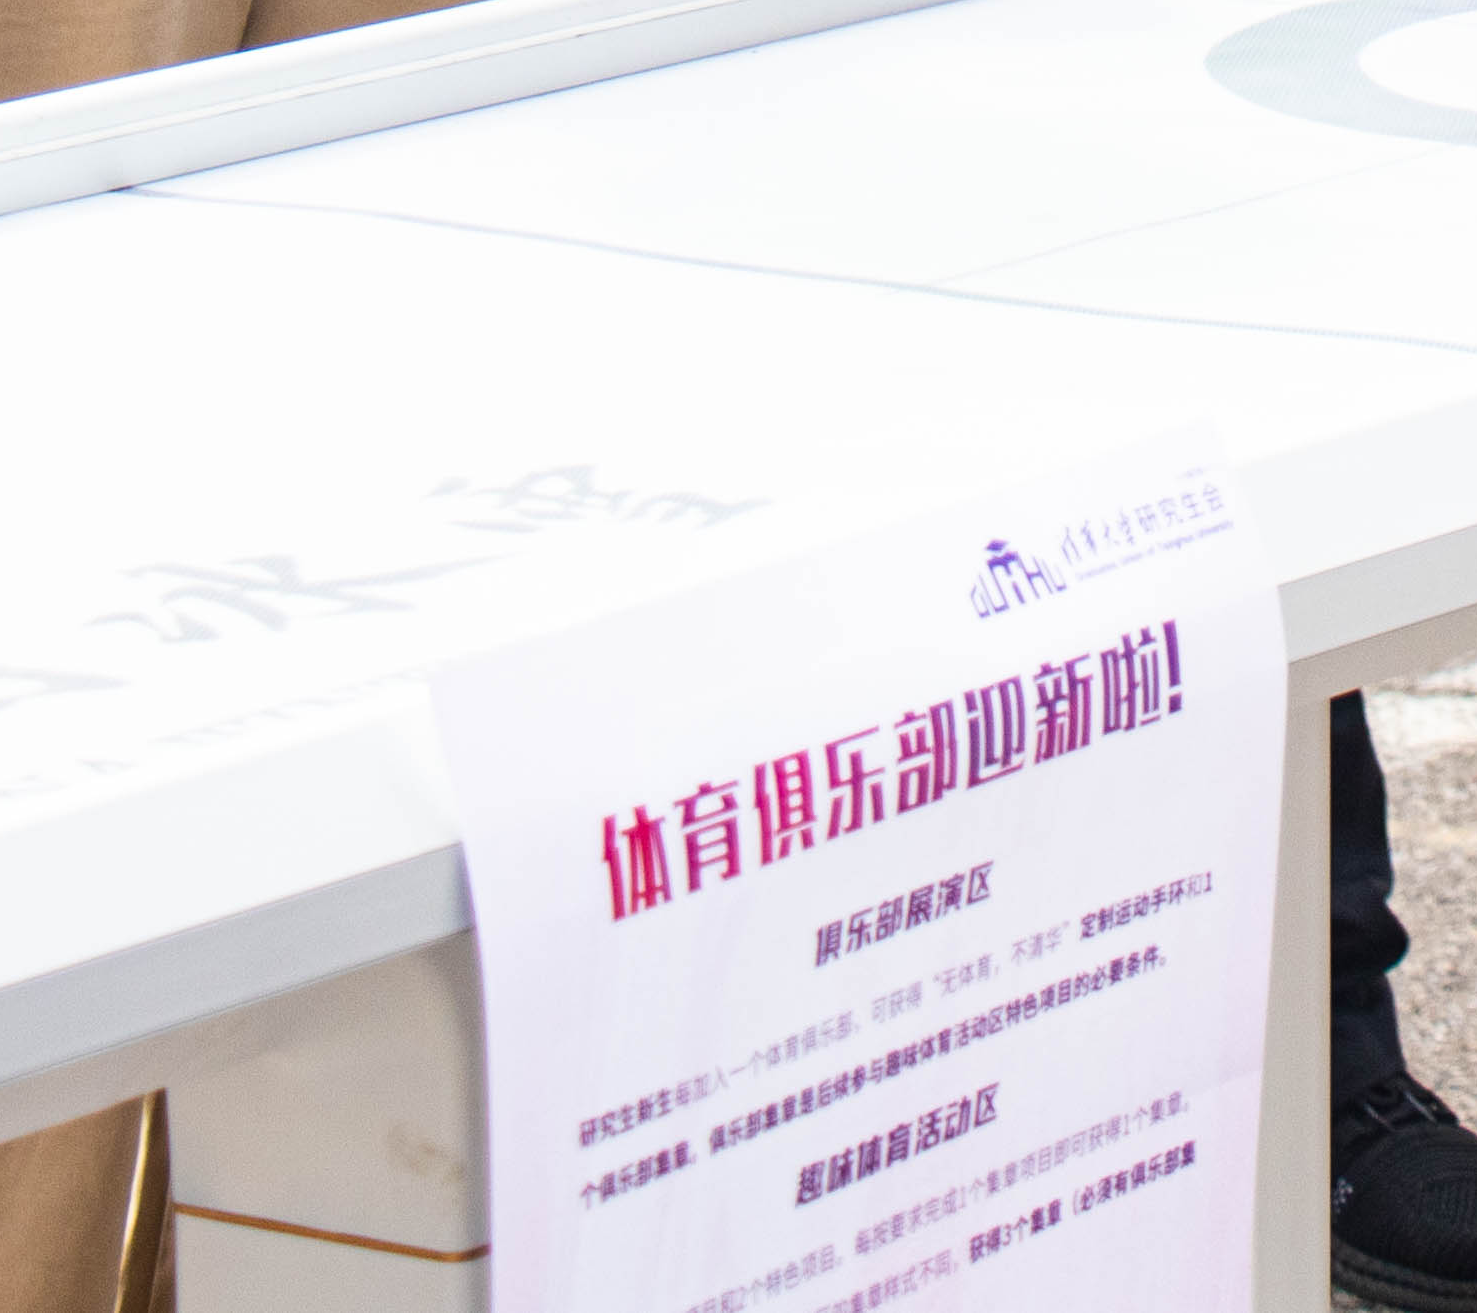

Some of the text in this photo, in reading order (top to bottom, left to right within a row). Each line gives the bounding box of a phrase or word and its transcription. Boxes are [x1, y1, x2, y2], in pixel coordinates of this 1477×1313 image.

[814, 860, 996, 968] 俱乐部展演区
[794, 1081, 1001, 1209] 趣味体育活动区
